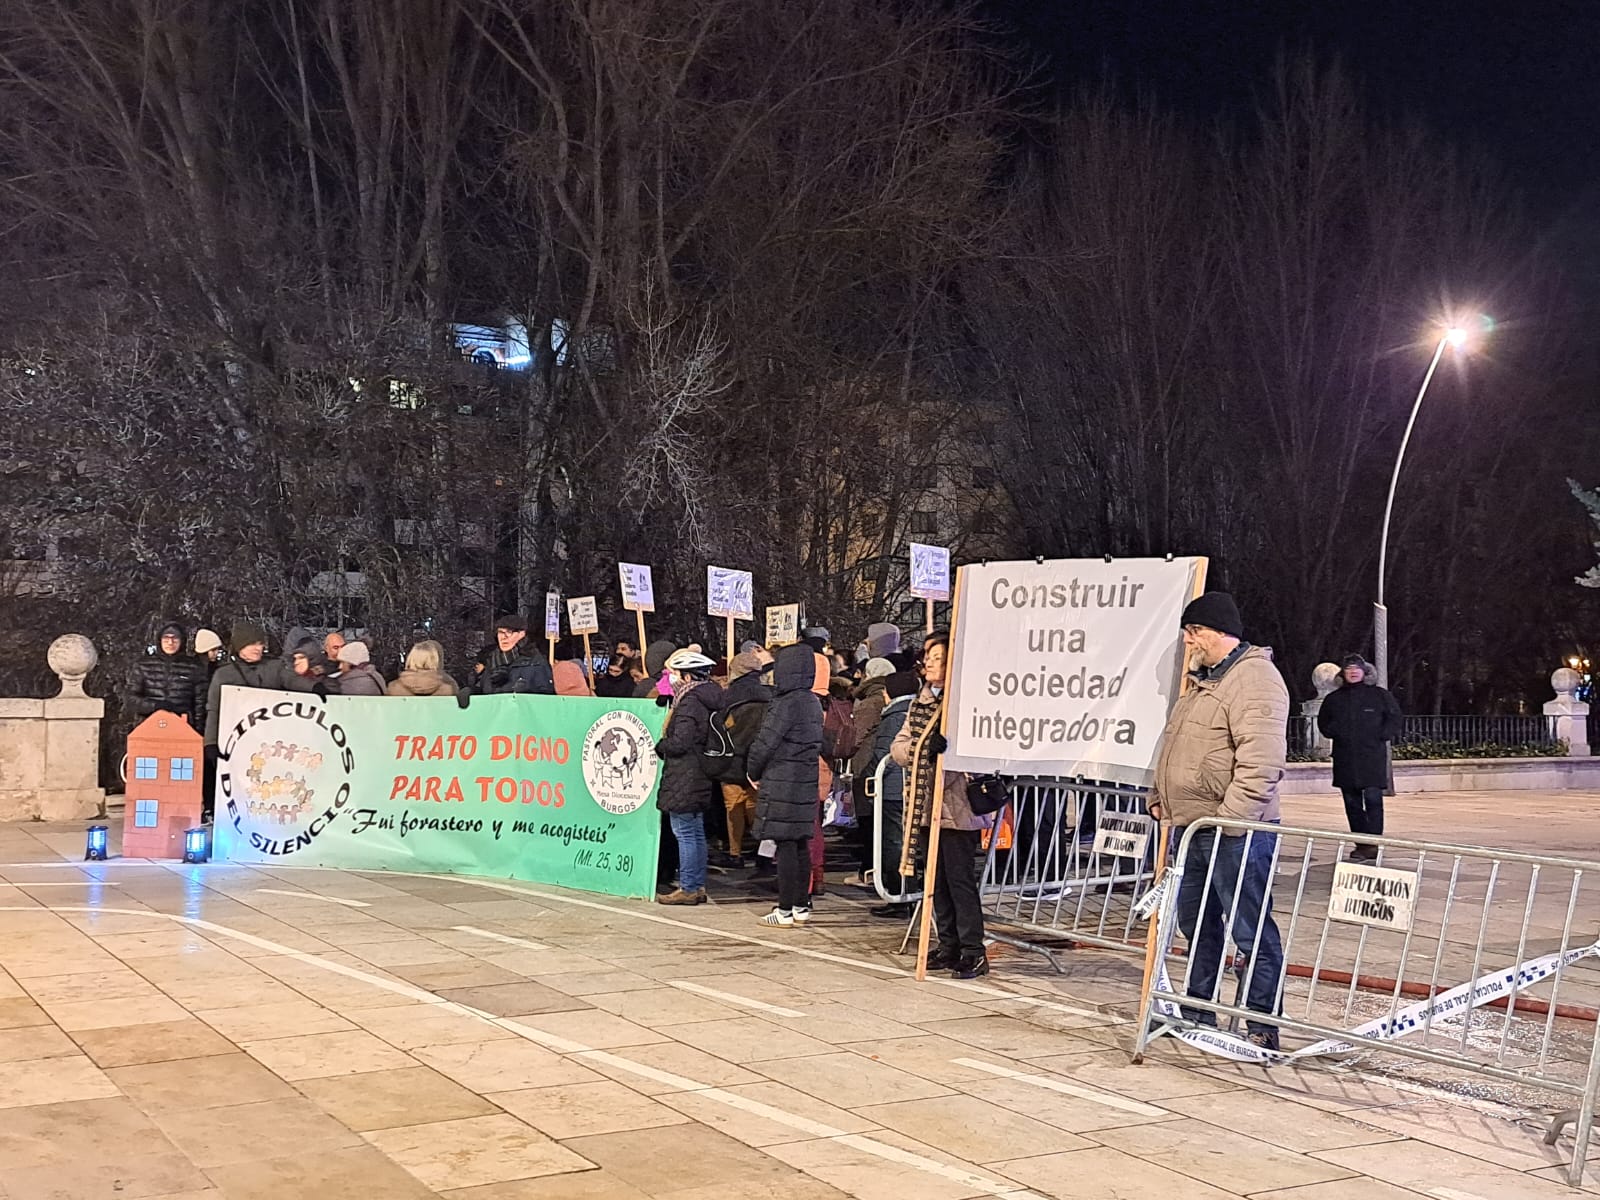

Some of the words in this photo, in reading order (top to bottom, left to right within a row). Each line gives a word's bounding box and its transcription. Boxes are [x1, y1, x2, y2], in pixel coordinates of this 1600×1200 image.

[991, 576, 1144, 609] Construir
[1028, 628, 1086, 653] una
[988, 666, 1128, 699] sociedad
[220, 702, 355, 775] CIRCULOS
[583, 720, 604, 761] PASTORAL
[607, 711, 622, 721] CON
[626, 712, 657, 766] INMIGRANTES
[972, 707, 1136, 750] integradora
[394, 735, 478, 761] TRATO
[489, 733, 570, 765] DIGNO
[221, 773, 243, 834] DEL
[389, 775, 465, 803] PARA
[475, 776, 566, 808] TODOS
[601, 798, 637, 813] BURGOS
[249, 782, 350, 855] SILENCIO
[400, 809, 483, 838] forastero
[492, 820, 503, 840] y
[512, 820, 535, 833] me
[573, 849, 592, 869] (Mt.
[596, 851, 611, 872] 25,
[615, 854, 634, 877] 38)
[1344, 898, 1395, 922] BURGOS
